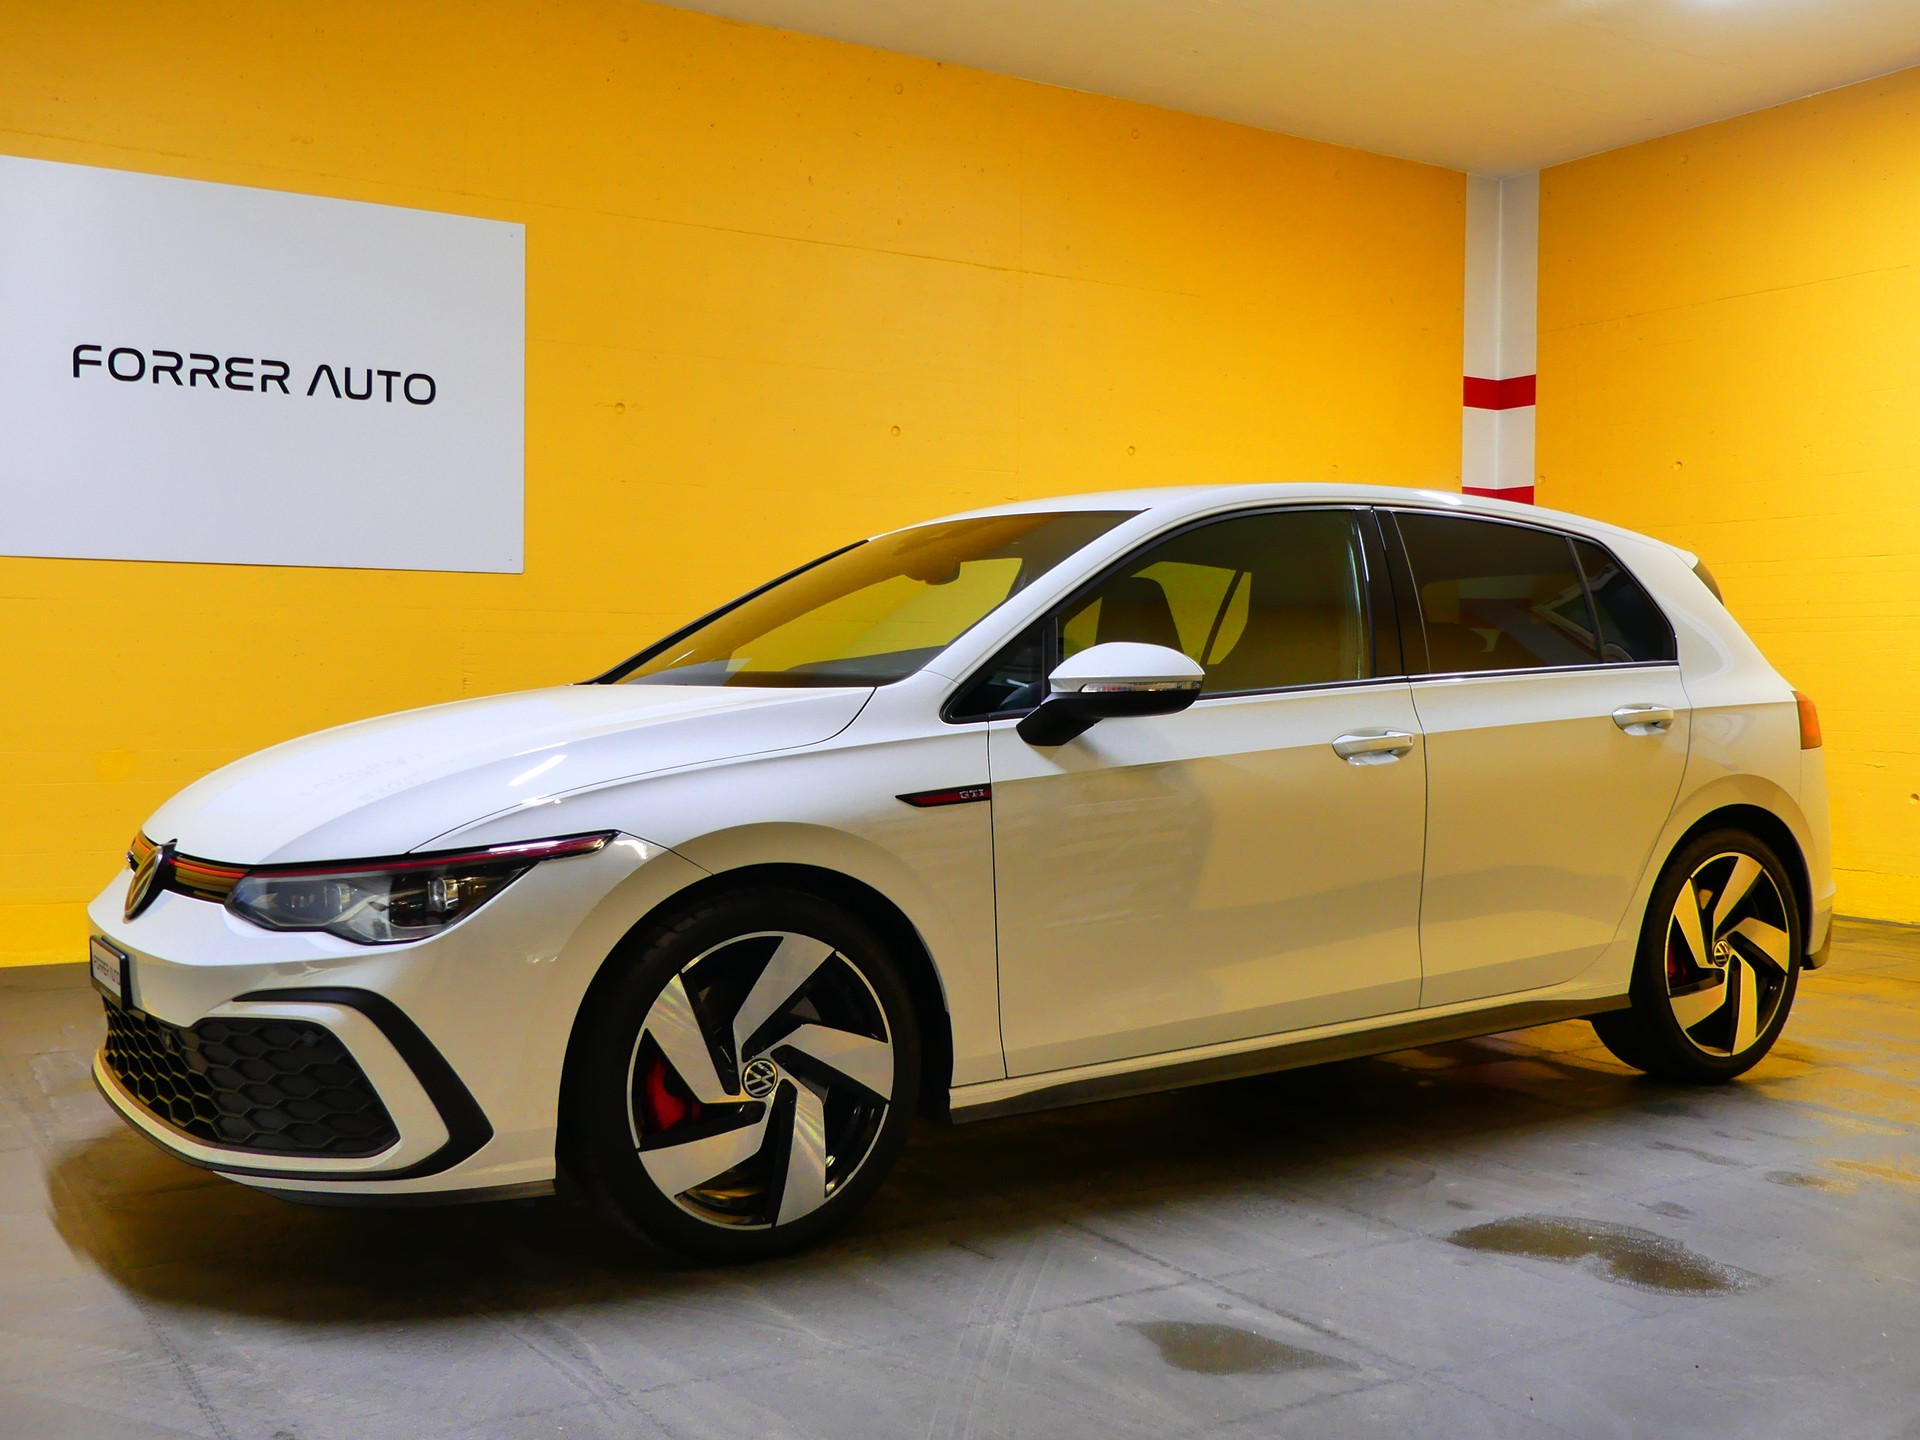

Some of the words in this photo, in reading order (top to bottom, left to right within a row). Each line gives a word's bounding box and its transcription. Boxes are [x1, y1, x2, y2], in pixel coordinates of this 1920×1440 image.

[72, 344, 291, 395] FORRER
[306, 364, 437, 405] AUTO
[959, 788, 984, 799] GTI
